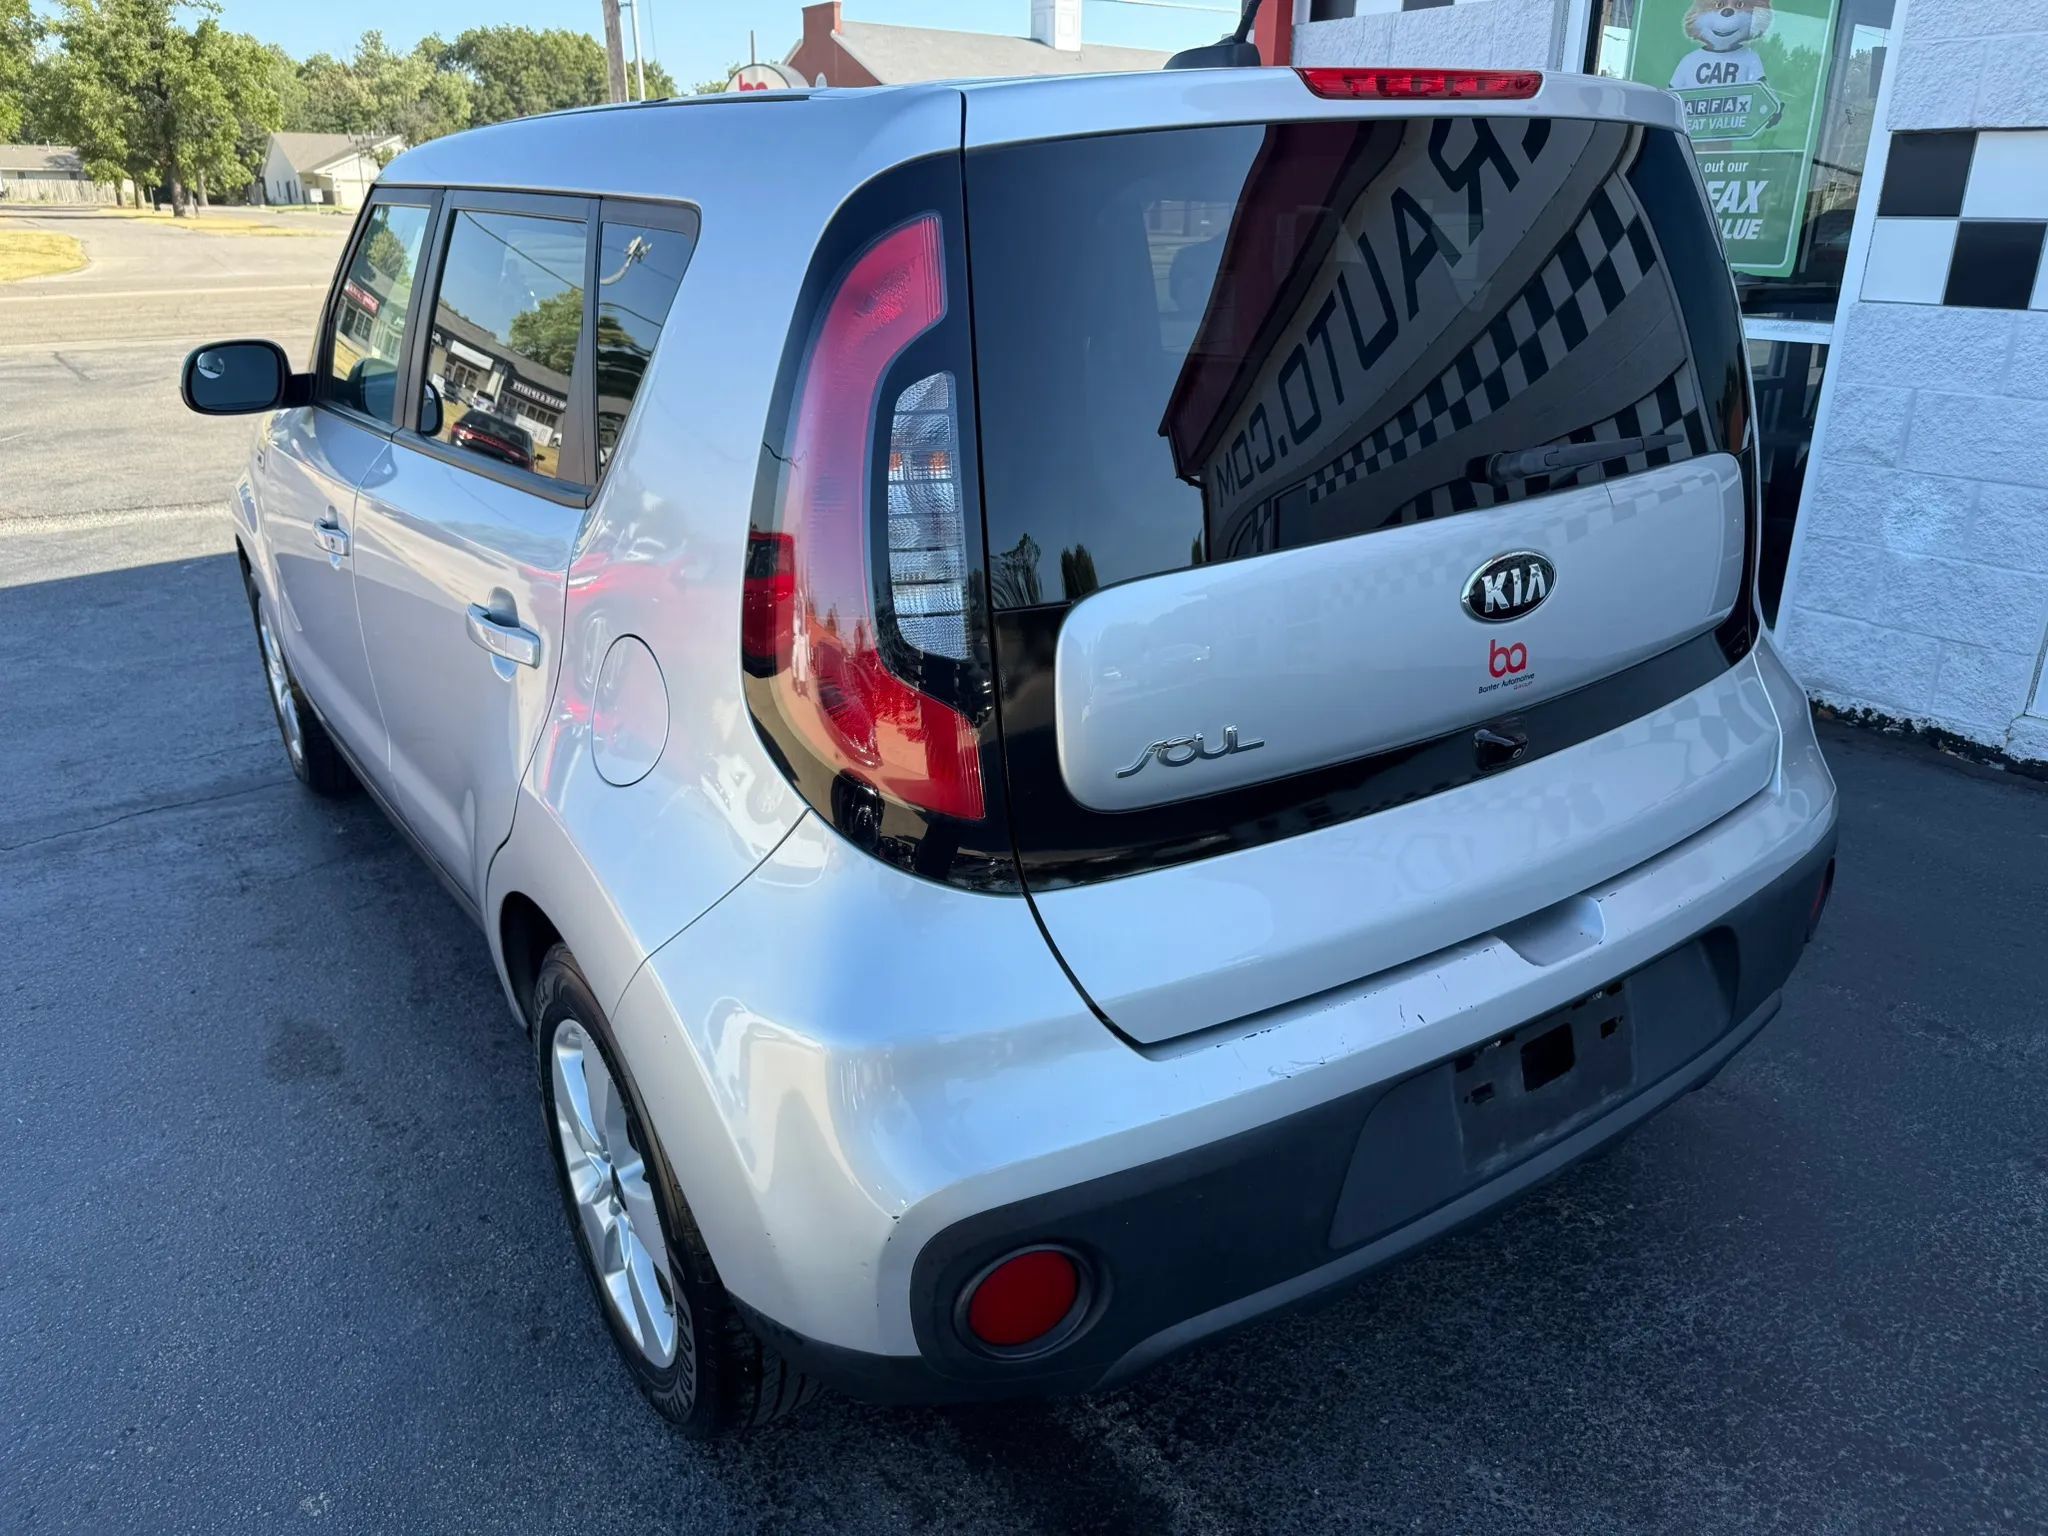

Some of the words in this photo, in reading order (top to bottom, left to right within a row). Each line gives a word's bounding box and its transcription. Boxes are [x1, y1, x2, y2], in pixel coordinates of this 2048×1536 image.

[1695, 62, 1739, 84] CAR
[1685, 97, 1749, 114] ARFAX
[1687, 118, 1706, 130] EAT
[1708, 116, 1747, 129] VALUE
[1704, 160, 1725, 173] out
[1727, 162, 1749, 173] our
[1707, 180, 1769, 214] FAX
[1718, 218, 1764, 240] LUE
[1481, 563, 1546, 613] KIA
[1501, 672, 1535, 688] Automotive
